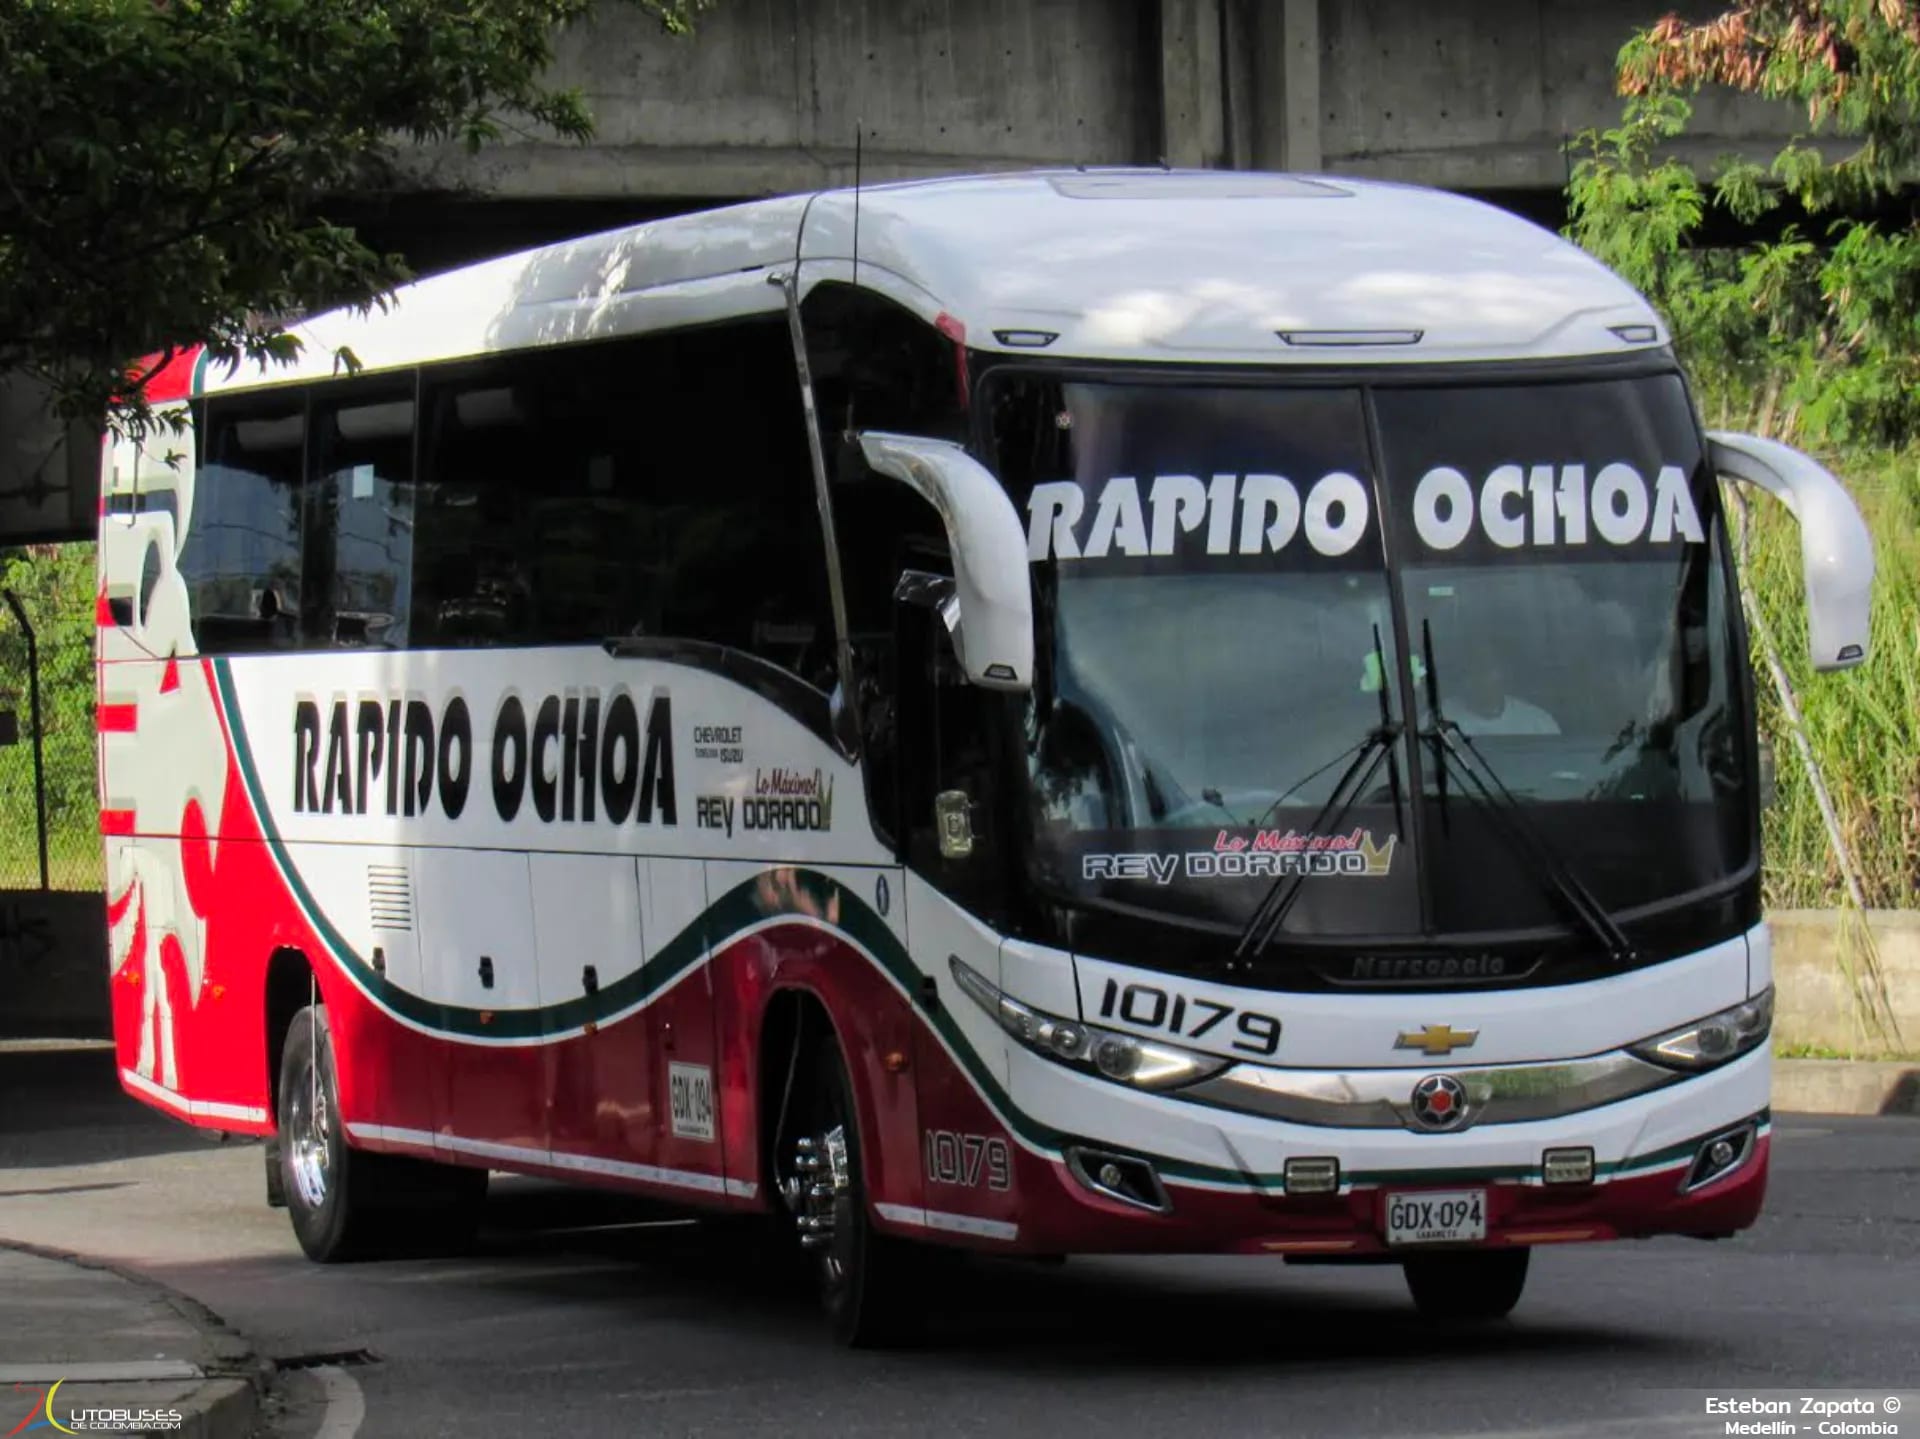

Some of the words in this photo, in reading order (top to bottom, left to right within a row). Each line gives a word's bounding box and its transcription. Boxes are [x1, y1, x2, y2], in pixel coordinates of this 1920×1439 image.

[1028, 471, 1370, 563] RAPIDO
[1413, 462, 1705, 550] OCHOA
[694, 726, 743, 744] CHEVROLET
[293, 690, 473, 821] RAPIDO
[491, 688, 679, 826] OCHOA
[755, 768, 770, 794] Lo
[742, 797, 822, 832] DORADO
[1213, 829, 1248, 852] Lo
[1083, 854, 1180, 885] REY
[1184, 851, 1368, 877] DORADO
[1100, 977, 1282, 1056] 10179
[925, 1129, 1012, 1192] 10179
